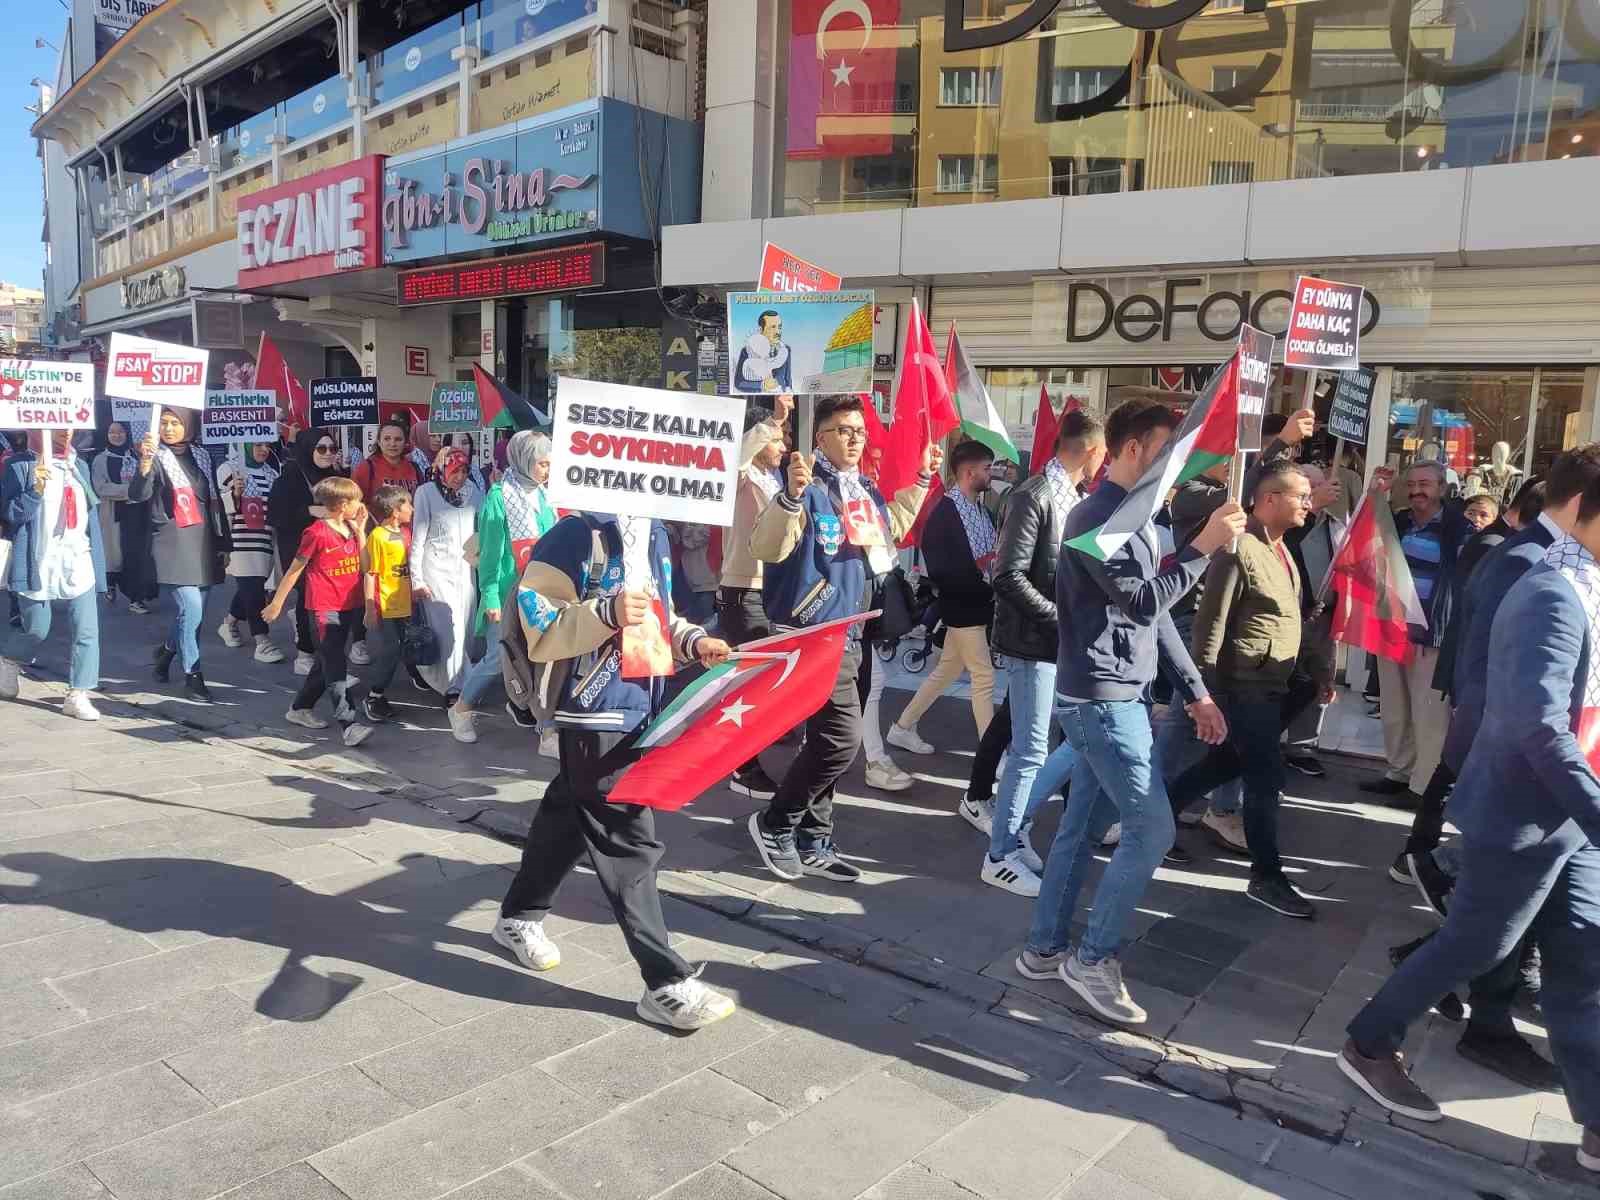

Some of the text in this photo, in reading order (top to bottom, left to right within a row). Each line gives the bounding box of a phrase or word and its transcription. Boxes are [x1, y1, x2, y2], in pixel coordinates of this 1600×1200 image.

[460, 157, 546, 235] Sina
[238, 177, 365, 269] ECZANE
[1301, 287, 1352, 311] EY DÜNYA
[1296, 312, 1351, 337] DAHA KAÇ
[1289, 339, 1354, 357] ÇOCUK ÖLMELİ?
[116, 355, 198, 383] #SAY STOP!
[409, 351, 425, 371] E
[3, 367, 83, 382] FİLİSTİN'DE
[313, 381, 374, 395] MÜSLÜMAN
[439, 387, 474, 403] ÖZGÜR
[16, 397, 57, 405] PARMAK
[208, 392, 270, 406] FİLİSTİN'İN
[313, 398, 375, 409] ZULME BOYUN
[17, 406, 73, 423] İSRAİL
[211, 408, 266, 422] BAŞKENTİ
[323, 409, 365, 421] EĞMEZ!
[434, 407, 479, 421] FİLİSTİN
[567, 403, 735, 441] SESSİZ KALMA
[206, 424, 274, 438] KUDÜS'TÜR.
[569, 430, 726, 472] SOYKIRIMA
[566, 465, 725, 501] ORTAK OLMA!
